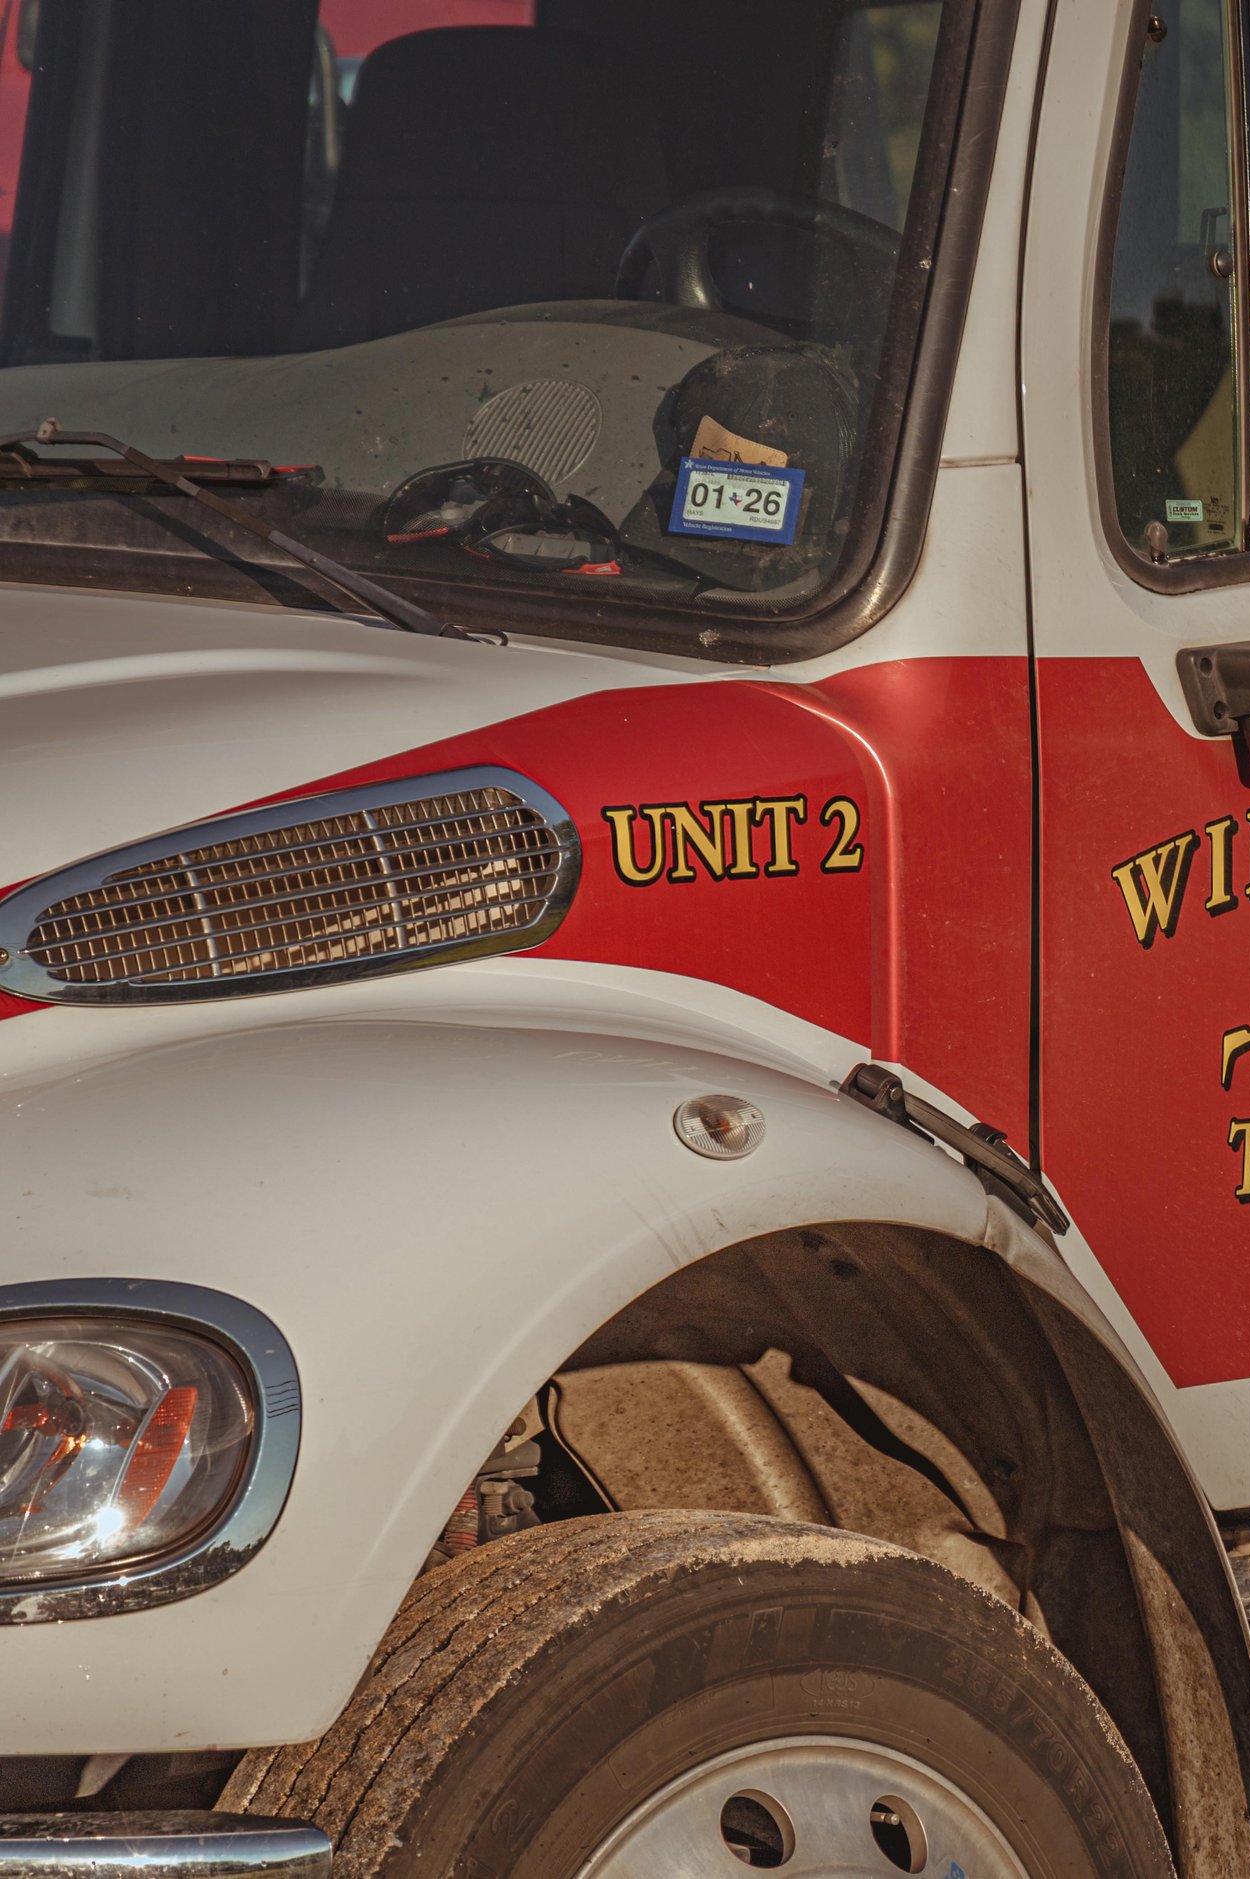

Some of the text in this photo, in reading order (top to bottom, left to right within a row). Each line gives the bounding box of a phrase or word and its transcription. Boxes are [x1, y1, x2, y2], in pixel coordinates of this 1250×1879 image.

[691, 482, 782, 515] 01 26
[601, 793, 864, 887] UNIT 2
